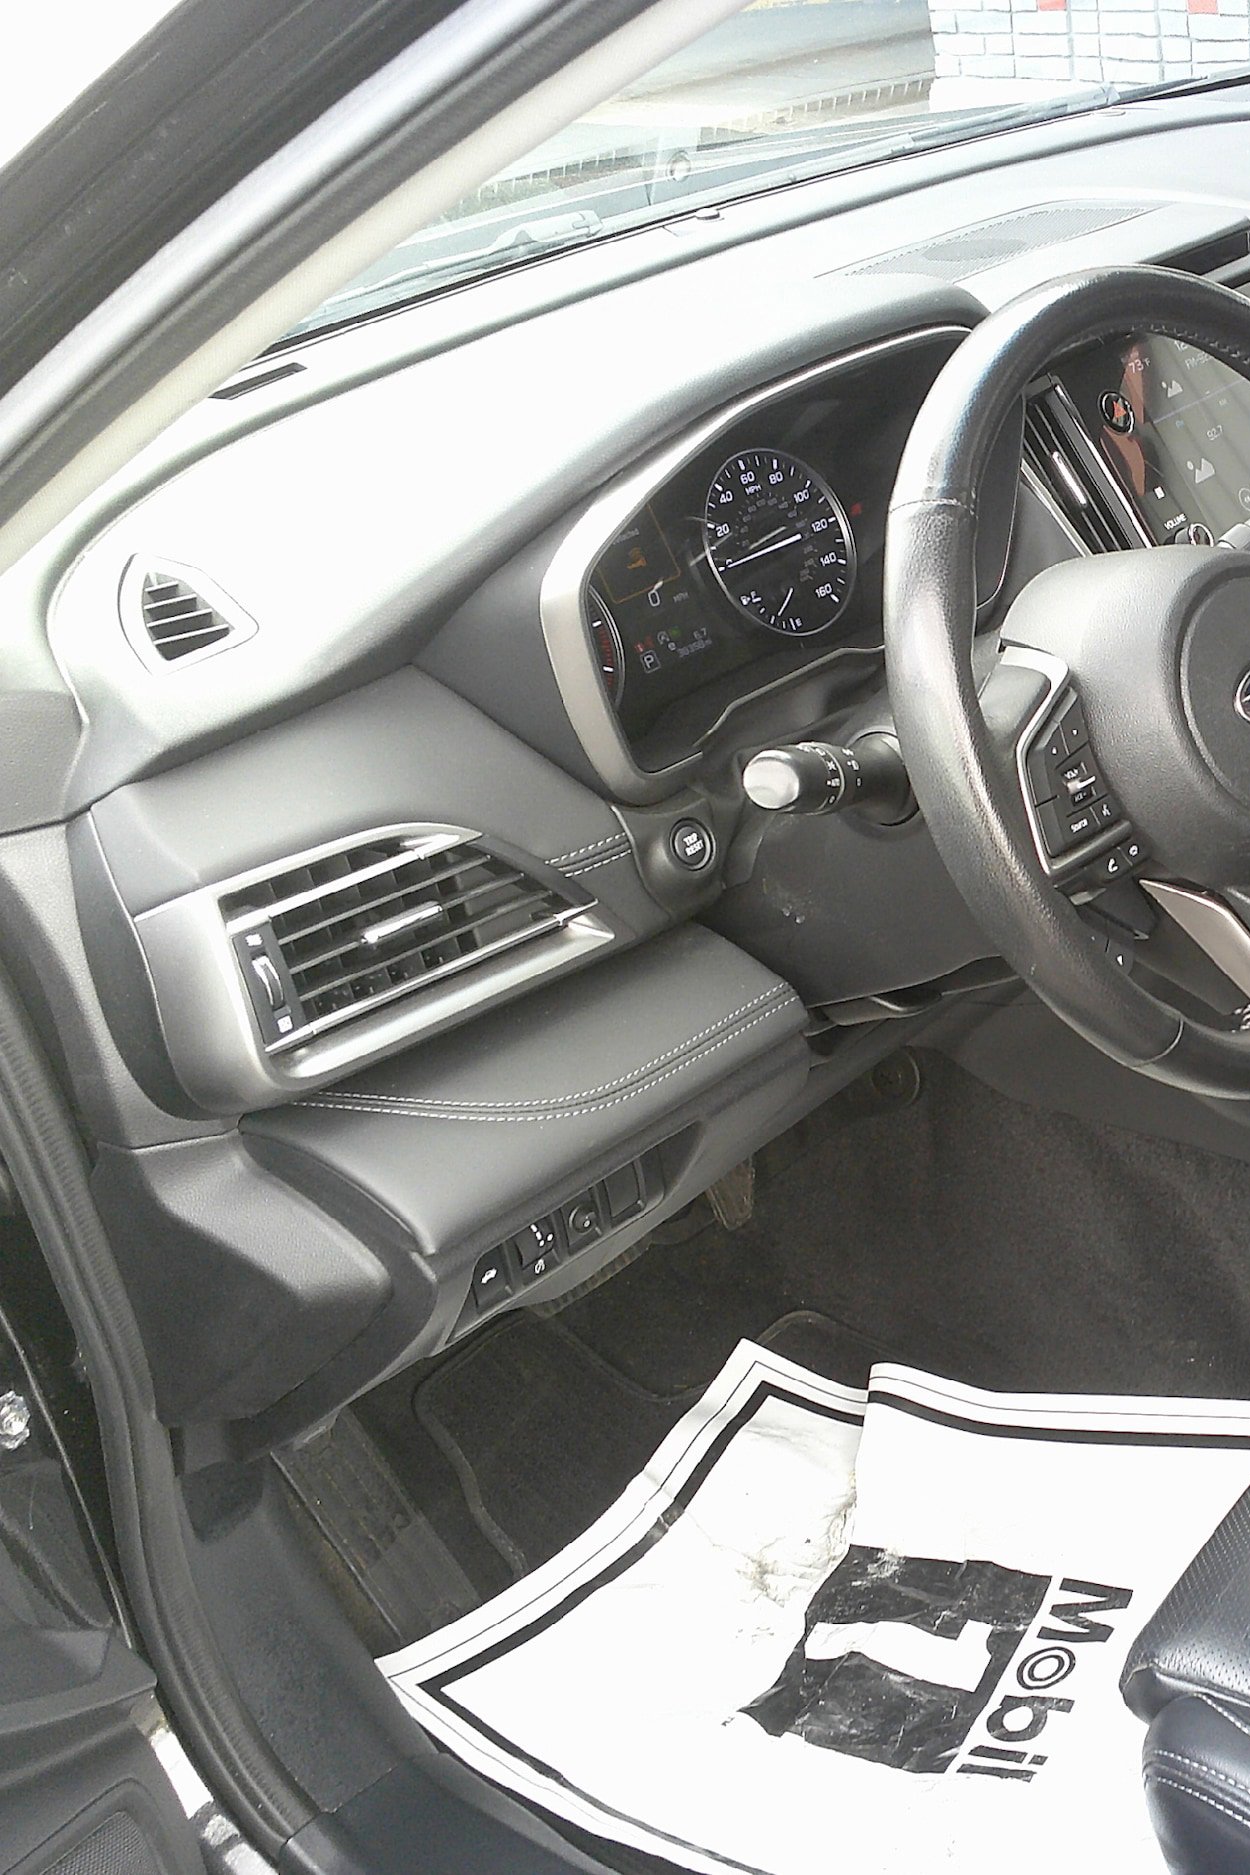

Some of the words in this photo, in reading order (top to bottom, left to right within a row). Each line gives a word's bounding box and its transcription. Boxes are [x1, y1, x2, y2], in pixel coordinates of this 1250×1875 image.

[740, 471, 755, 485] 60
[769, 471, 783, 485] 80
[745, 484, 762, 495] MPH
[794, 489, 810, 503] 100
[719, 491, 733, 503] 40
[811, 518, 828, 533] 120
[1164, 513, 1188, 531] VOLUME
[716, 523, 730, 537] 20
[820, 552, 837, 566] 140
[815, 583, 832, 598] 160
[956, 1577, 1133, 1783] Mobil
